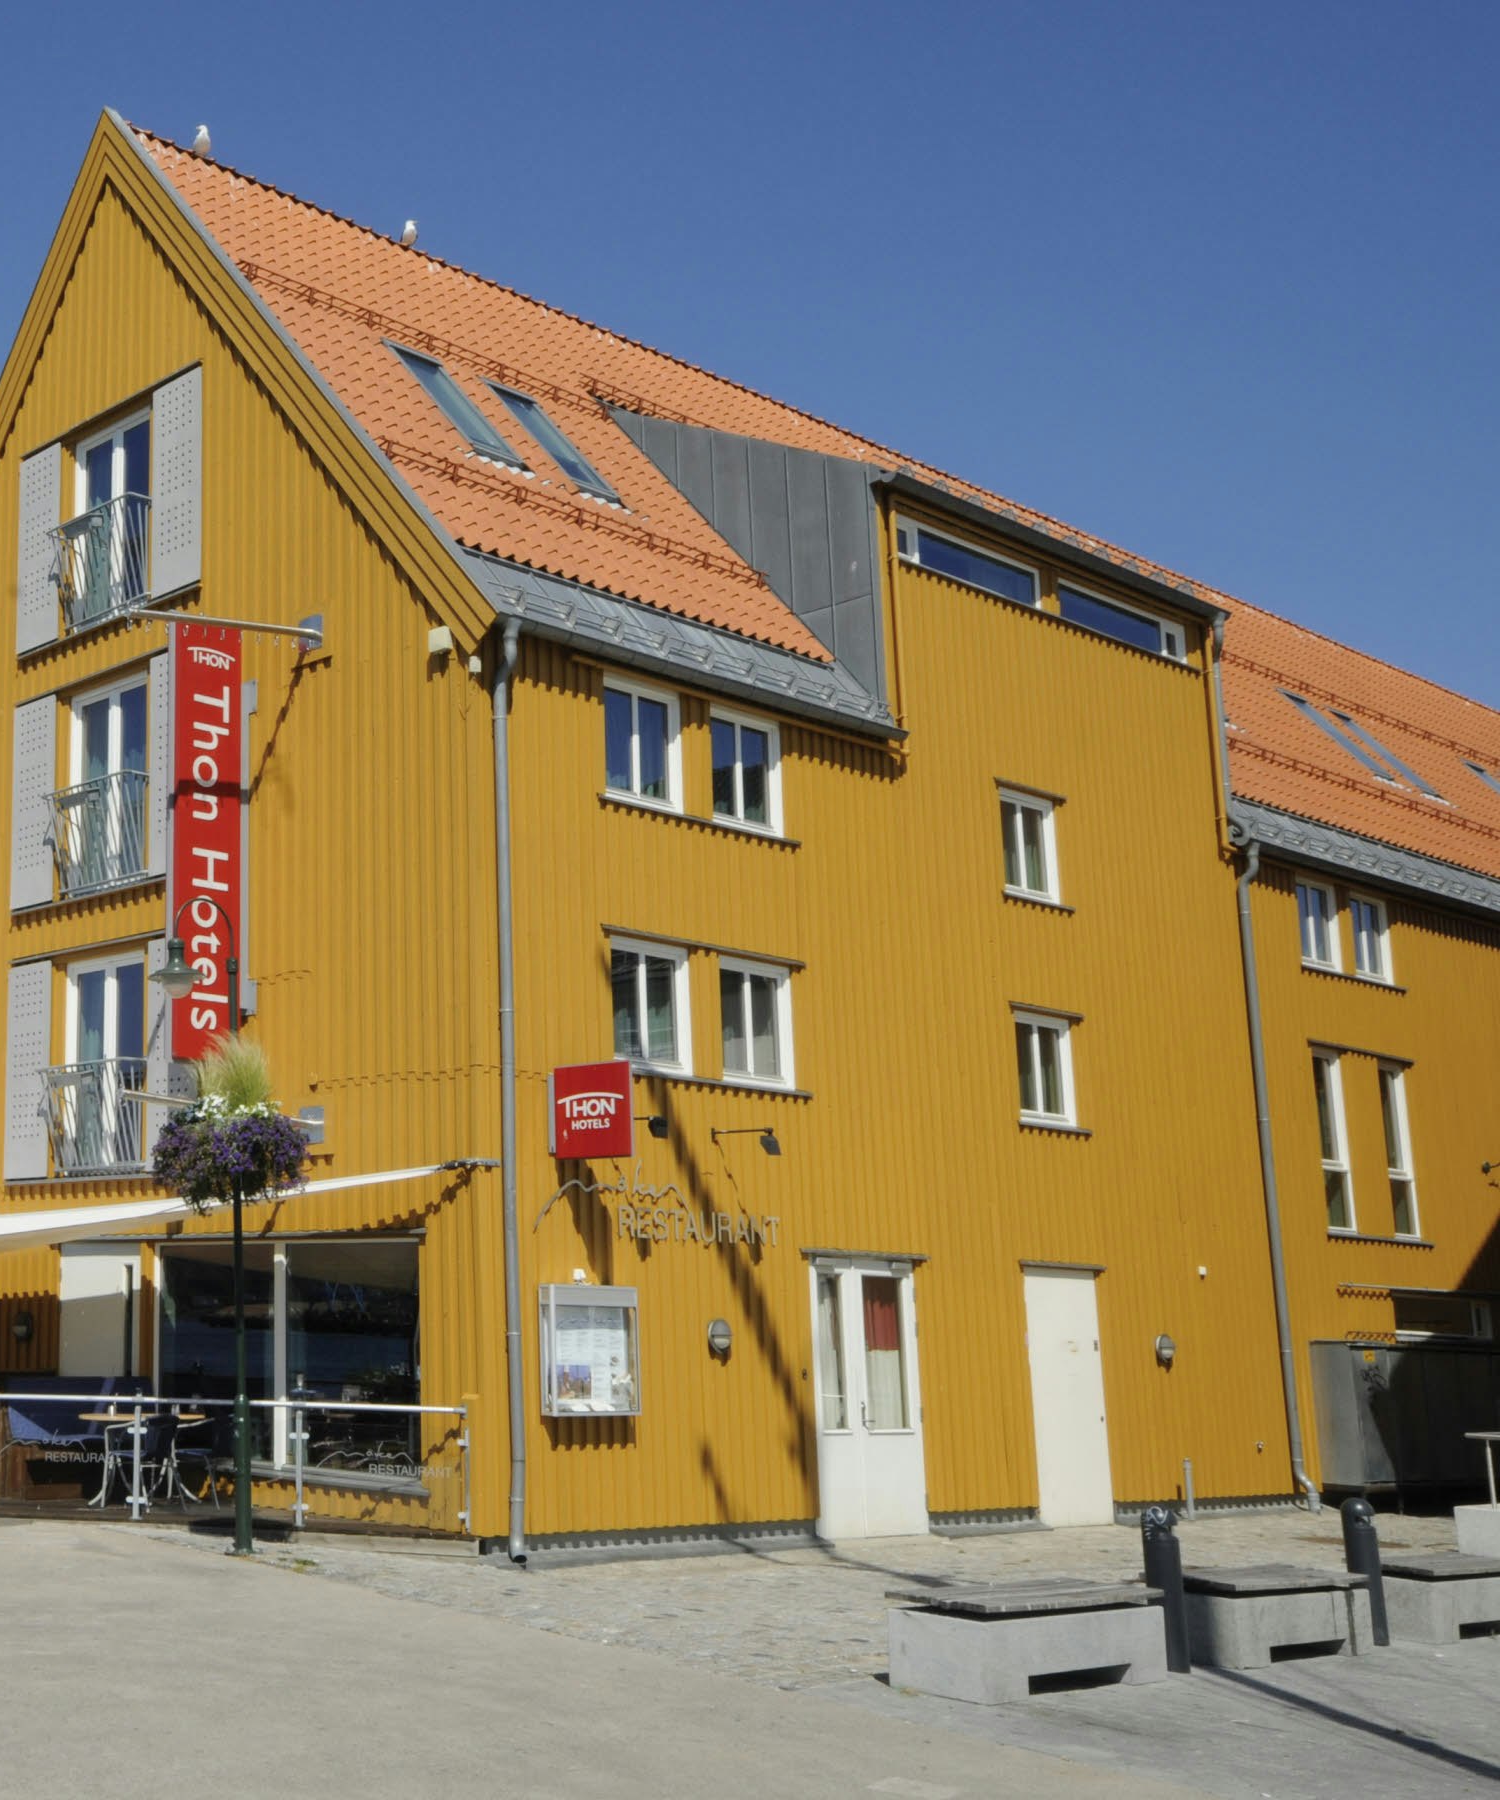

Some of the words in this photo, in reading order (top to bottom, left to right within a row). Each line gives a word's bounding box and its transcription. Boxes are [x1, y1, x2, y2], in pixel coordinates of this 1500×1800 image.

[187, 646, 236, 671] THON
[192, 685, 230, 821] Thon
[190, 847, 229, 1030] Hotels
[557, 1091, 624, 1118] THON
[571, 1117, 611, 1131] HOTELS
[618, 1205, 780, 1247] RESTAURANT
[44, 1451, 113, 1464] RESTAURA
[368, 1463, 451, 1478] RESTAURANT
